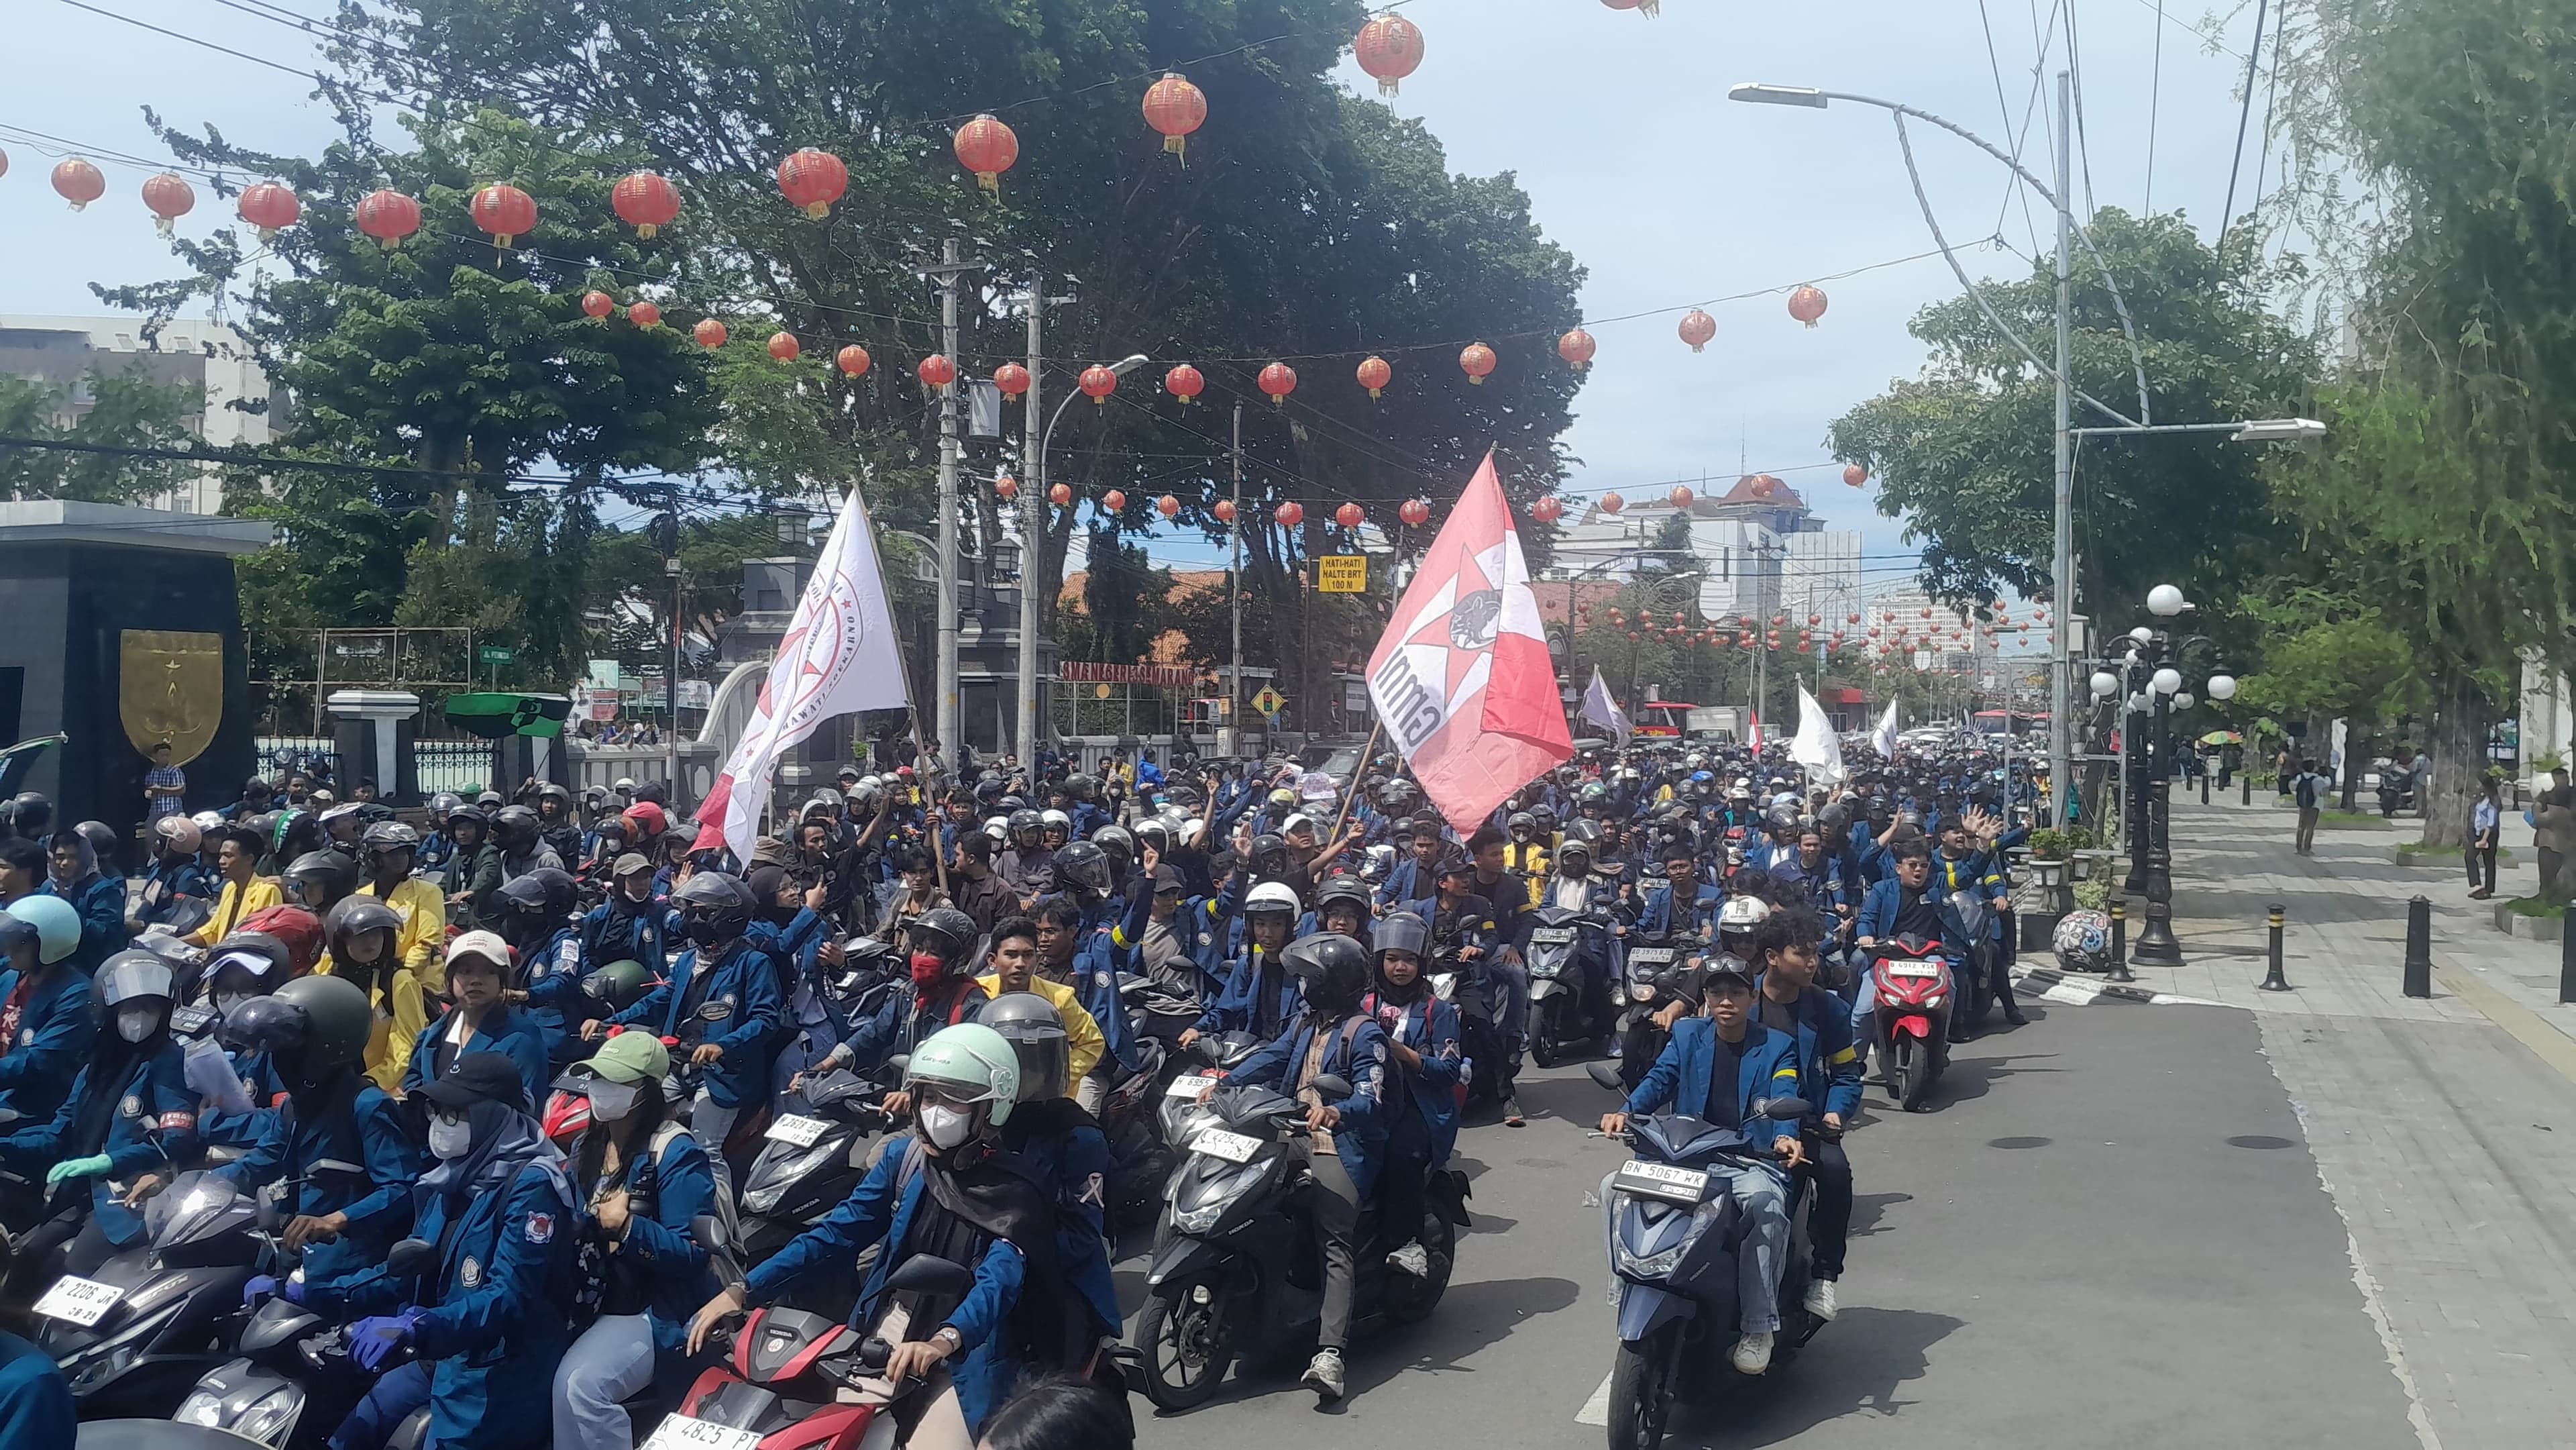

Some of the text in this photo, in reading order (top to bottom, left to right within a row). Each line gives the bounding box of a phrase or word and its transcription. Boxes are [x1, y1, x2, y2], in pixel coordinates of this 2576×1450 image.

[1326, 559, 1360, 568] HATI-HATI
[1323, 570, 1362, 578] HALTE BRT
[1332, 580, 1344, 589] 100
[1139, 664, 1195, 686] SEMARANG
[1176, 1077, 1211, 1088] H 6955
[1625, 1161, 1703, 1186] BN 5067 WK
[792, 1198, 820, 1214] HONDA
[1228, 1219, 1254, 1235] HONDA
[66, 1282, 99, 1300] 2206
[769, 1329, 793, 1338] HONDA
[659, 1415, 761, 1450] K 4825 PT
